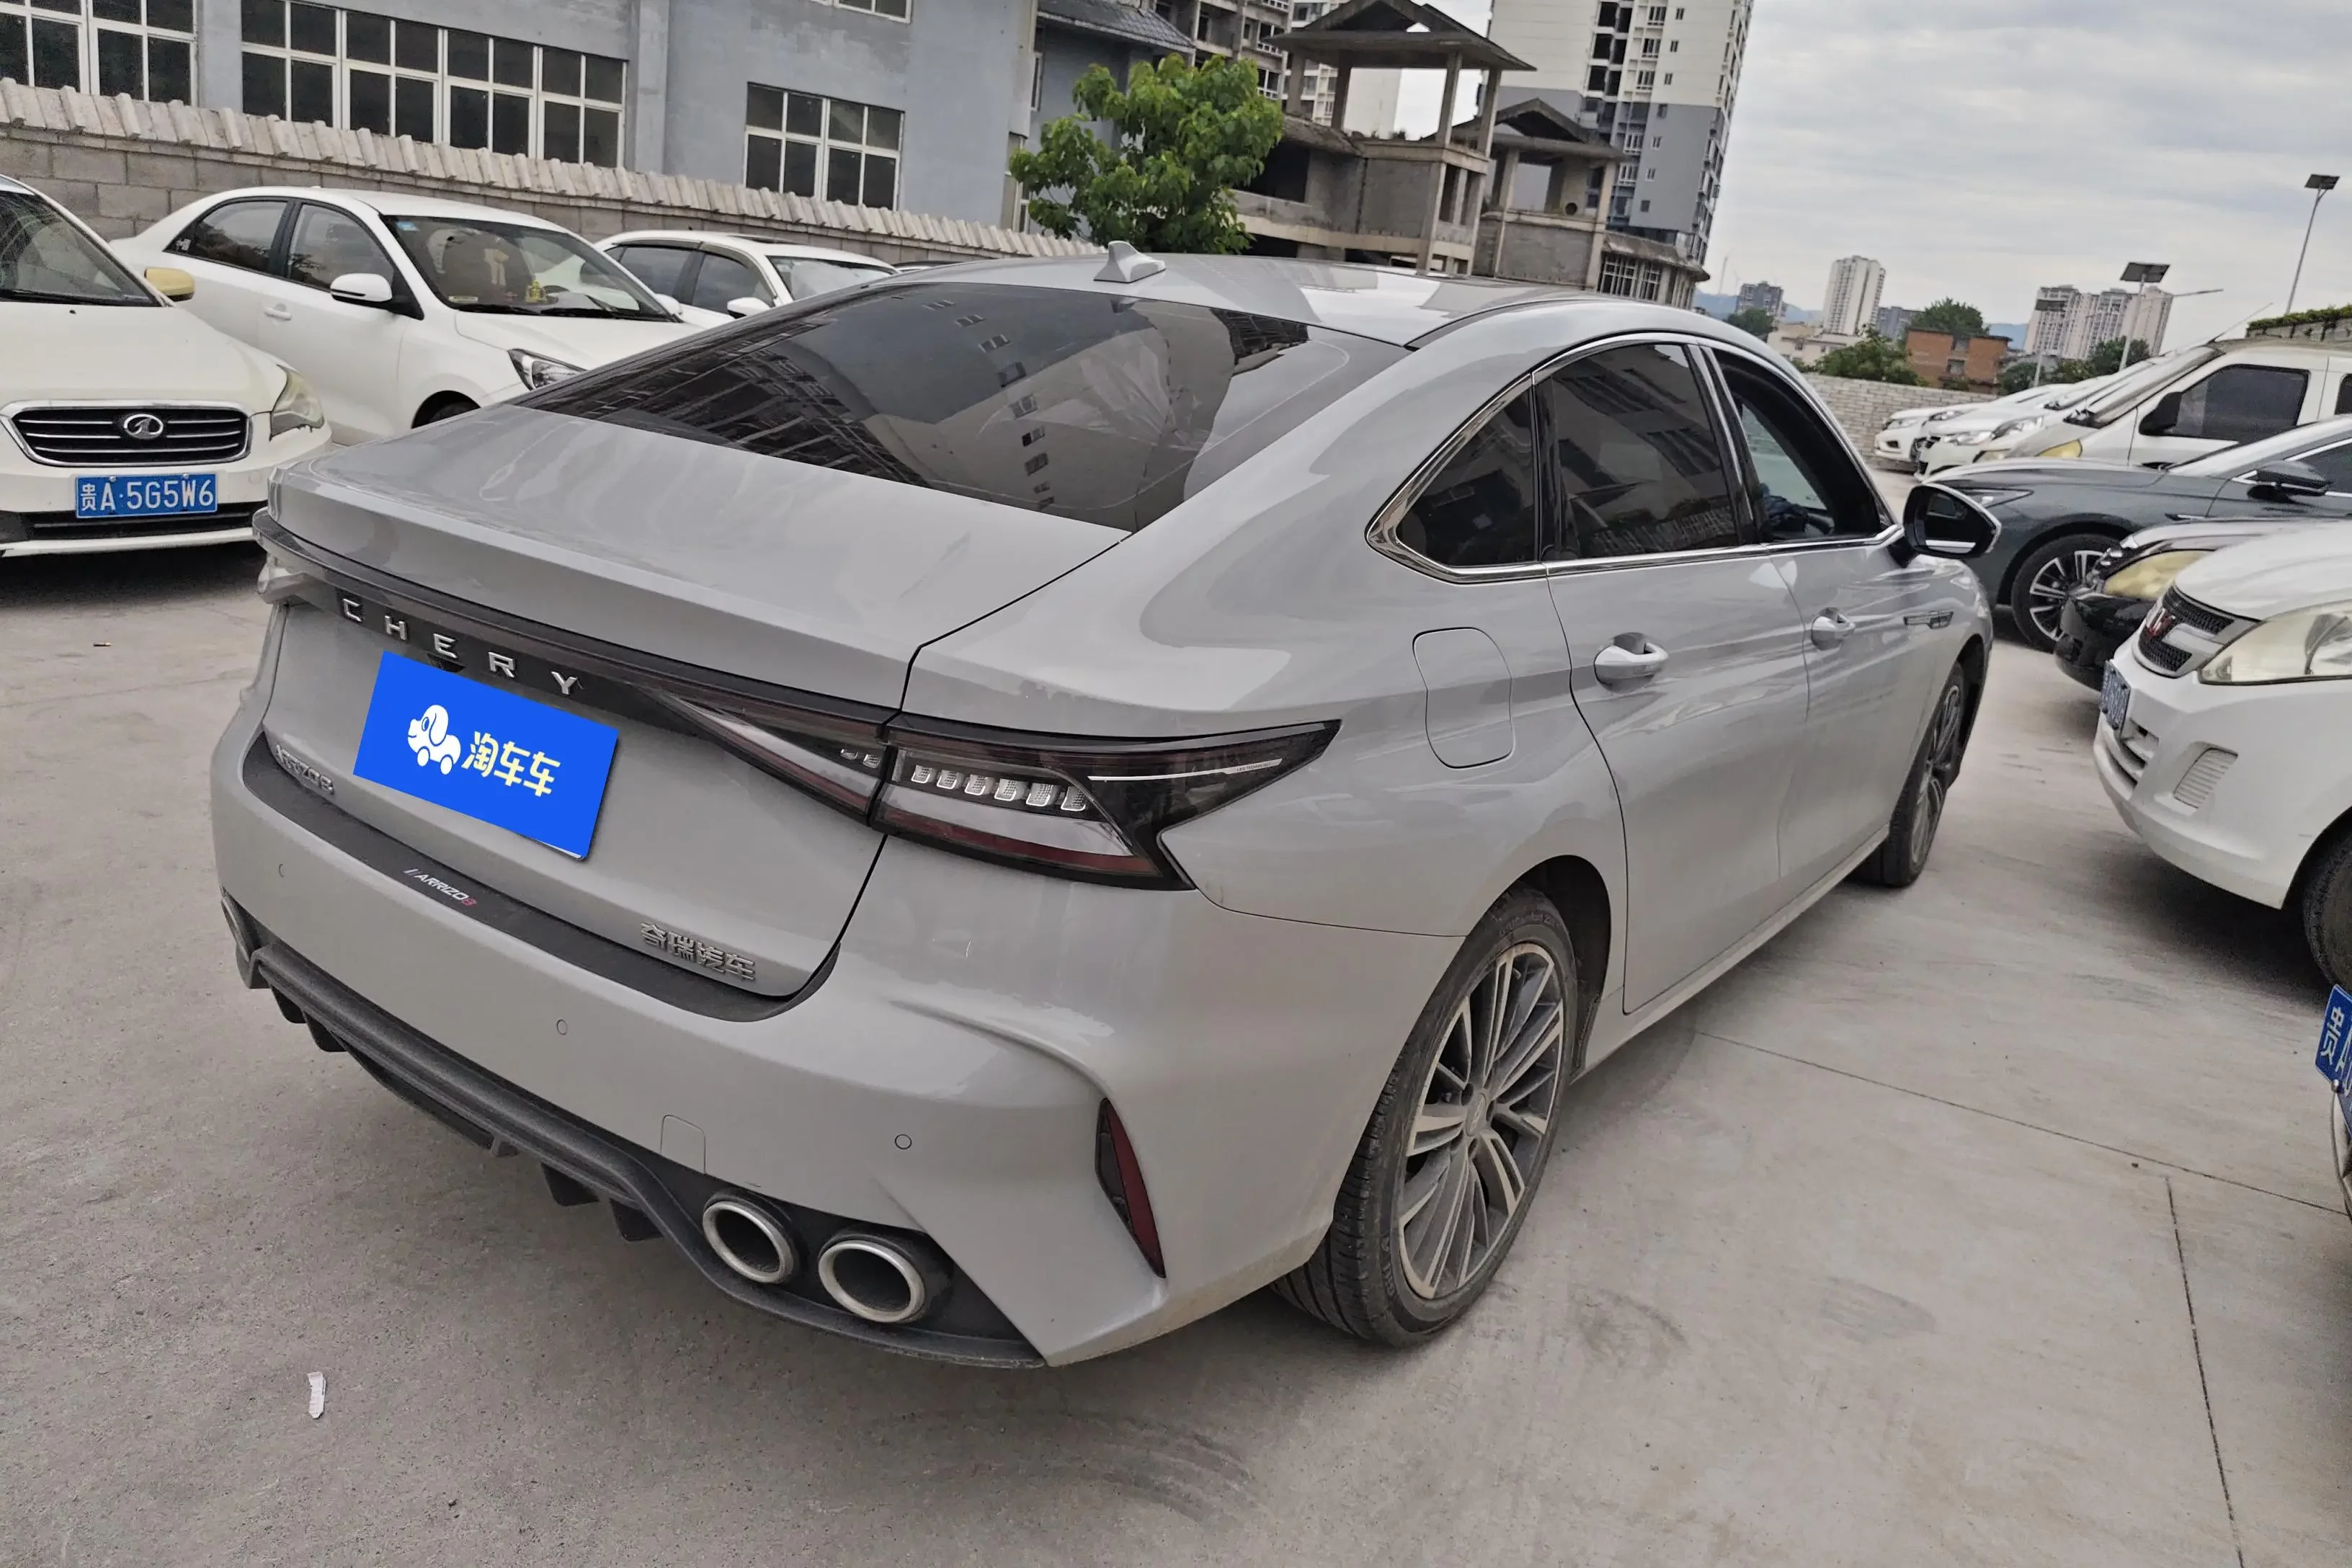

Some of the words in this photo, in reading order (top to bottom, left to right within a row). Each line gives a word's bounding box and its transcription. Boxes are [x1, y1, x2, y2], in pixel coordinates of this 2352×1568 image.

[342, 597, 579, 695] CHERY
[641, 922, 756, 981] 奇瑞汽车
